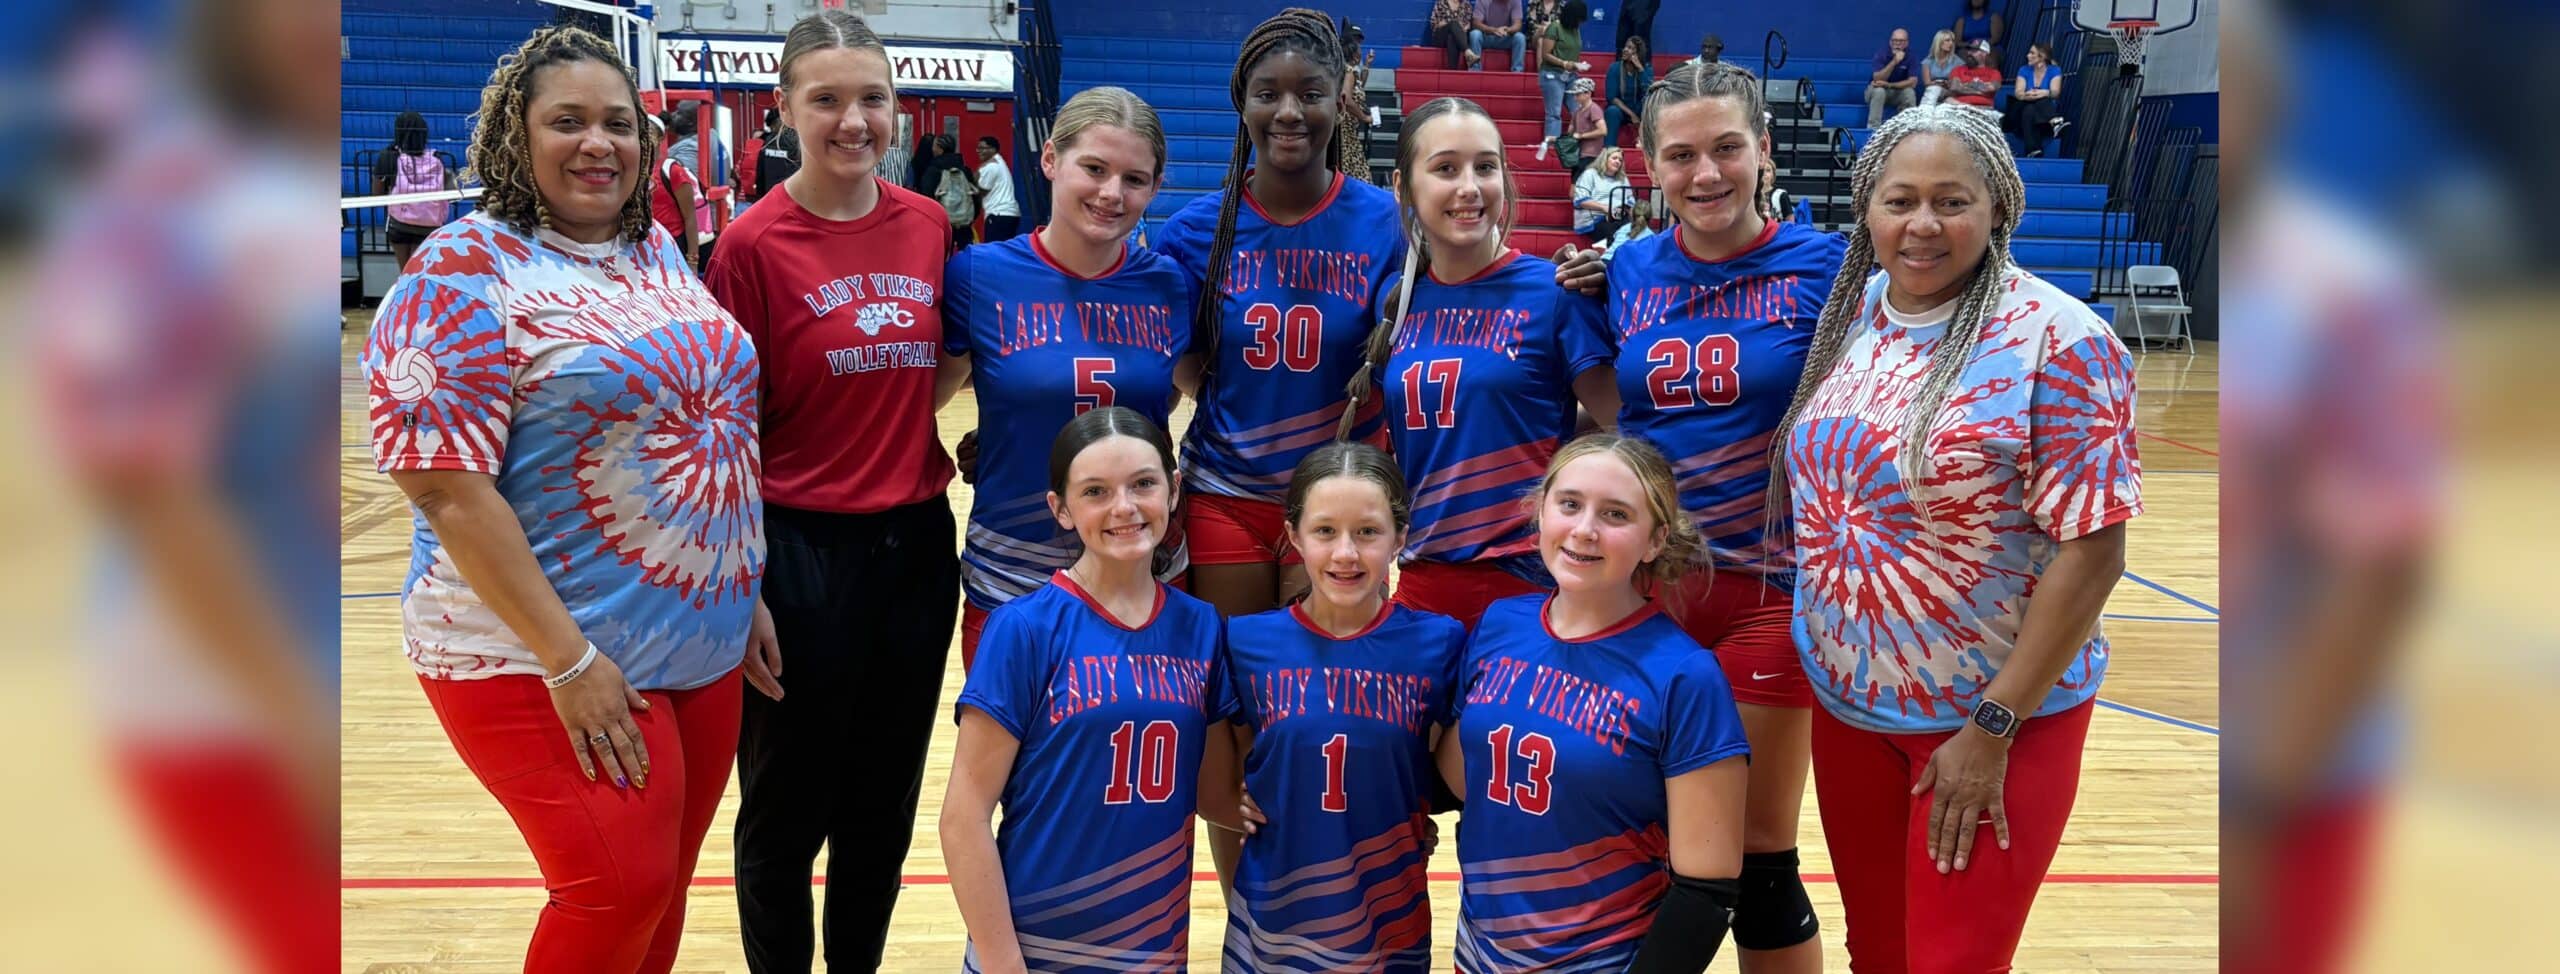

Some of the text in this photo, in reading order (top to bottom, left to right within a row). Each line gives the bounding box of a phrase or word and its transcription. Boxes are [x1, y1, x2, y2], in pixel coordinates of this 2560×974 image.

[804, 273, 934, 318] LADY VIKES
[1222, 249, 1370, 310] ADY VIKINGS
[1619, 274, 1798, 344] LADY VIKINGS
[826, 342, 937, 376] VOLLEYBALL
[996, 302, 1172, 359] LADY VIKINGS
[1243, 303, 1322, 373] 30
[1391, 308, 1530, 361] DY VIKINGS
[1073, 357, 1116, 417] 5
[1402, 358, 1463, 430] 17
[1646, 333, 1740, 411] 28
[552, 668, 580, 686] COACH
[1049, 655, 1212, 727] LADY VIKING
[1250, 667, 1432, 736] LADY VIKINGS
[1526, 665, 1641, 757] VIKINGS
[1104, 720, 1179, 805] 10
[1321, 733, 1348, 812] 1
[1487, 723, 1556, 816] 13
